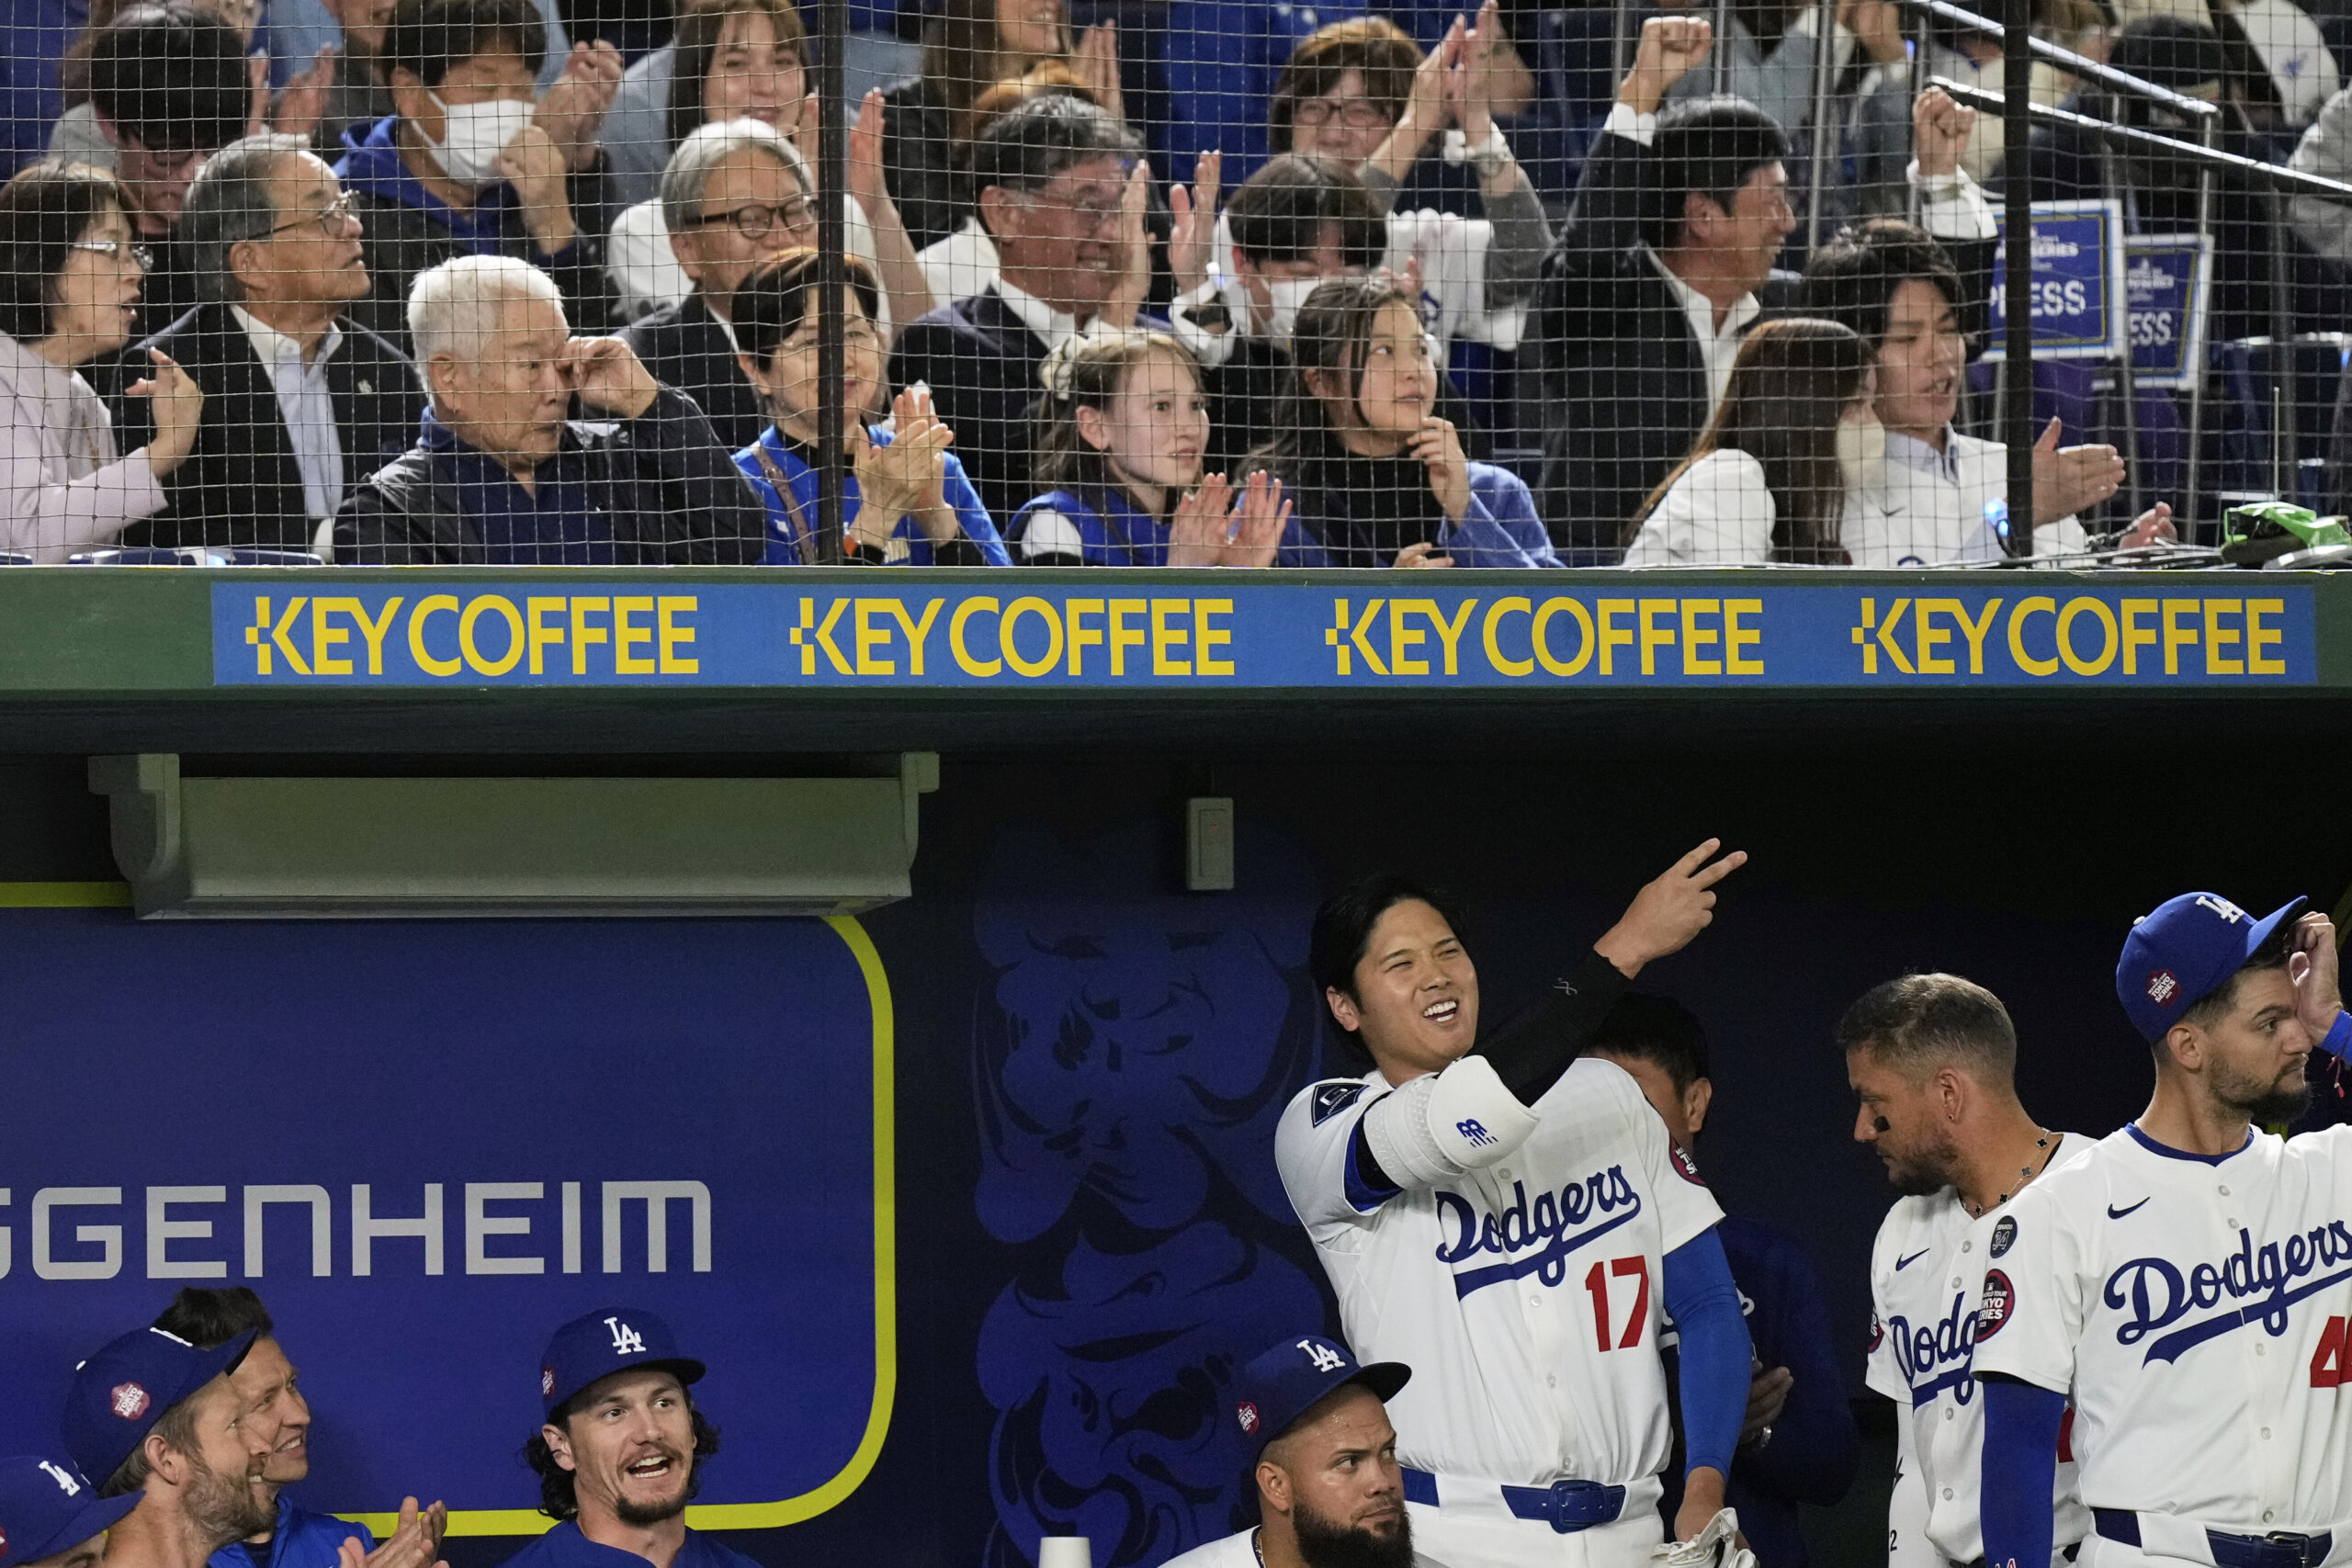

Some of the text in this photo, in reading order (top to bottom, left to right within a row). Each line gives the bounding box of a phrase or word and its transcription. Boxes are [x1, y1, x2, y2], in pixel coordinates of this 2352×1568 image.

[0, 1180, 712, 1280] GENHEIM
[1436, 1165, 1643, 1291] Dodgers
[1585, 1255, 1649, 1352] 17
[2104, 1220, 2352, 1345] Dodgers
[604, 1316, 647, 1355] LA
[1296, 1339, 1346, 1372] LA
[2310, 1315, 2352, 1388] 4
[38, 1461, 81, 1497] LA
